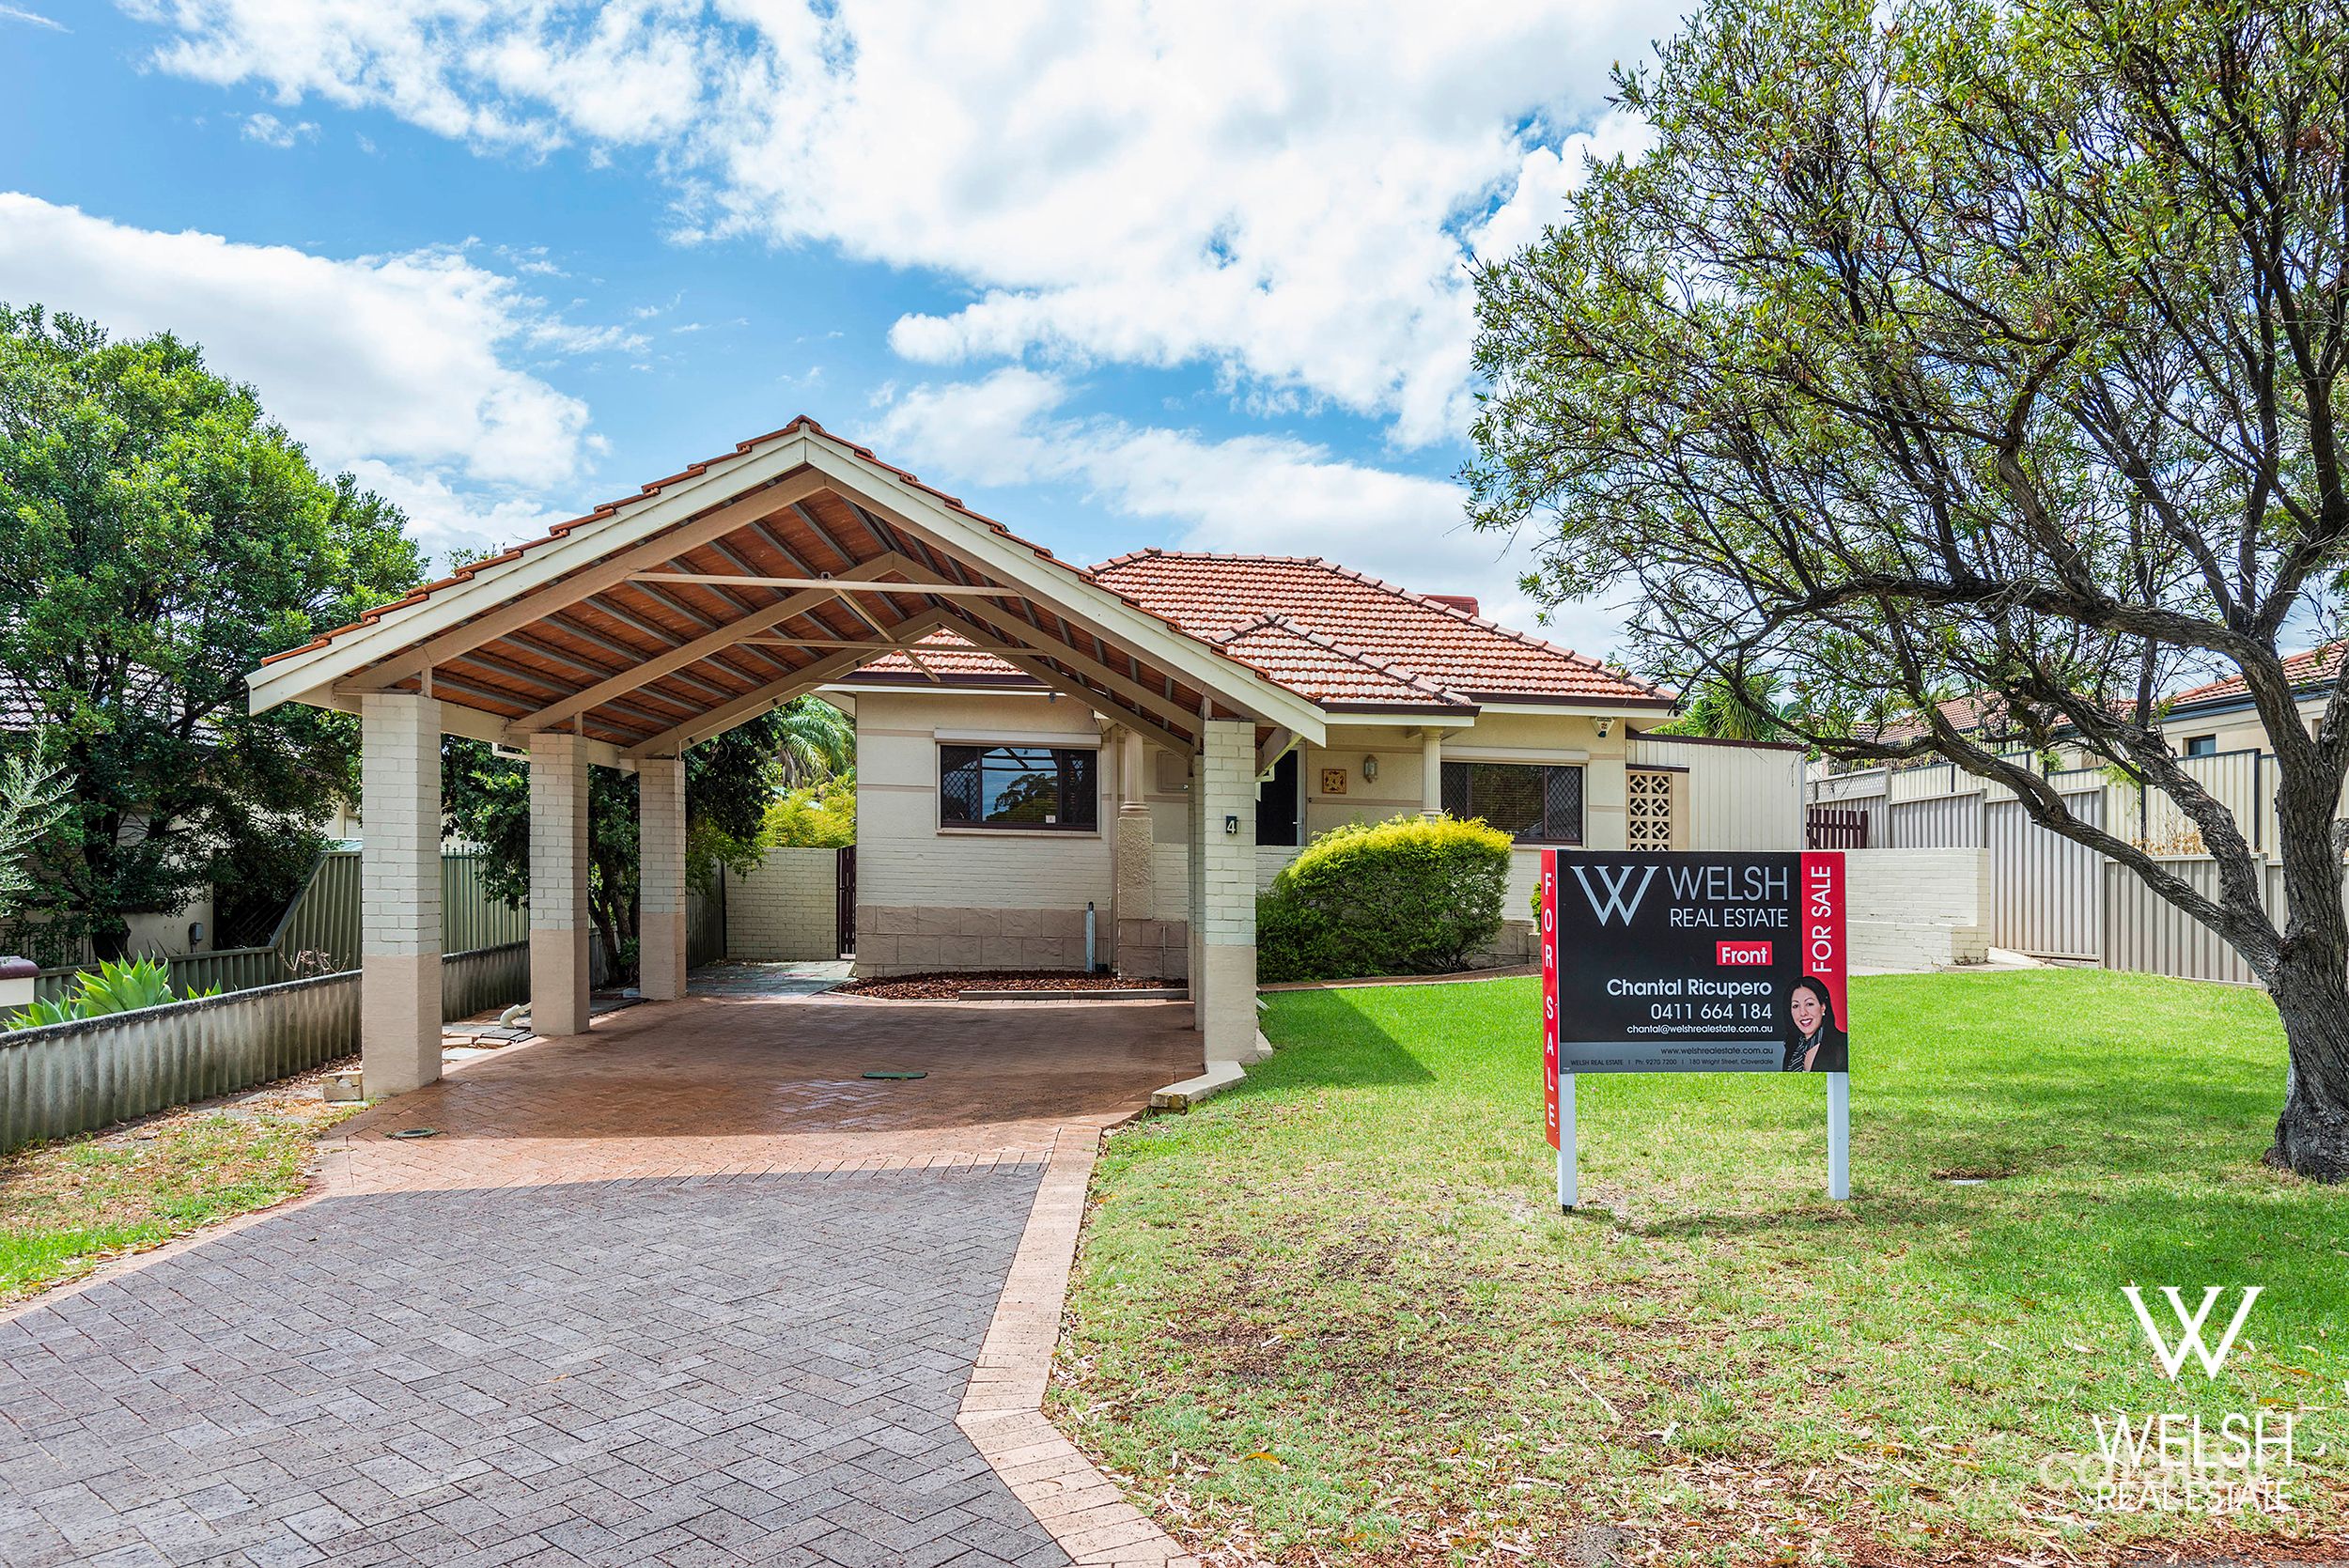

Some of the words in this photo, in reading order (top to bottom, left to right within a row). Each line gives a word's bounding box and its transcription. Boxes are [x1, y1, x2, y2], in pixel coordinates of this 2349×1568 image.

[1226, 819, 1237, 834] 4
[1666, 865, 1789, 902] WELSH
[1810, 865, 1832, 919] SALE
[1670, 908, 1719, 928] REAL
[1723, 908, 1789, 928] ESTATE
[1721, 946, 1768, 965] Front
[1811, 924, 1833, 973] FOR
[1606, 978, 1683, 997] Chantal
[1688, 978, 1773, 1000] Ricupero
[1650, 1002, 1692, 1020] 0411
[1700, 1002, 1734, 1020] 664
[1740, 1002, 1773, 1020] 184
[1626, 1024, 1774, 1034] chantal@welshrealestate.com.au
[1660, 1047, 1774, 1055] www.welshrealestate.com.au
